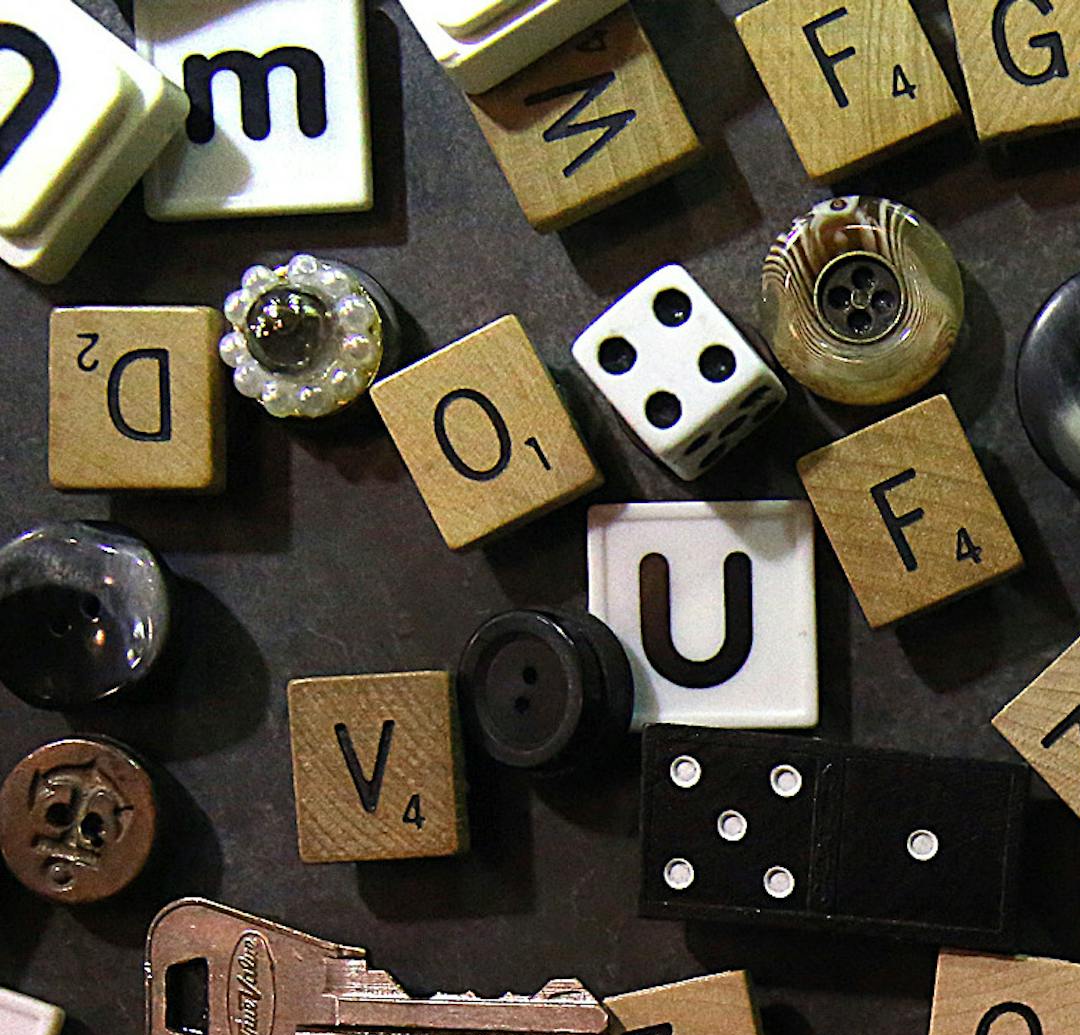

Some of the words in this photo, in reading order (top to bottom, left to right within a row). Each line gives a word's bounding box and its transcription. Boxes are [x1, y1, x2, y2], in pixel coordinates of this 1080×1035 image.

[802, 7, 855, 108] F
[992, 0, 1069, 86] G
[183, 45, 329, 145] m
[107, 348, 172, 442] D
[434, 388, 511, 481] O
[870, 468, 924, 572] F
[334, 720, 395, 814] V
